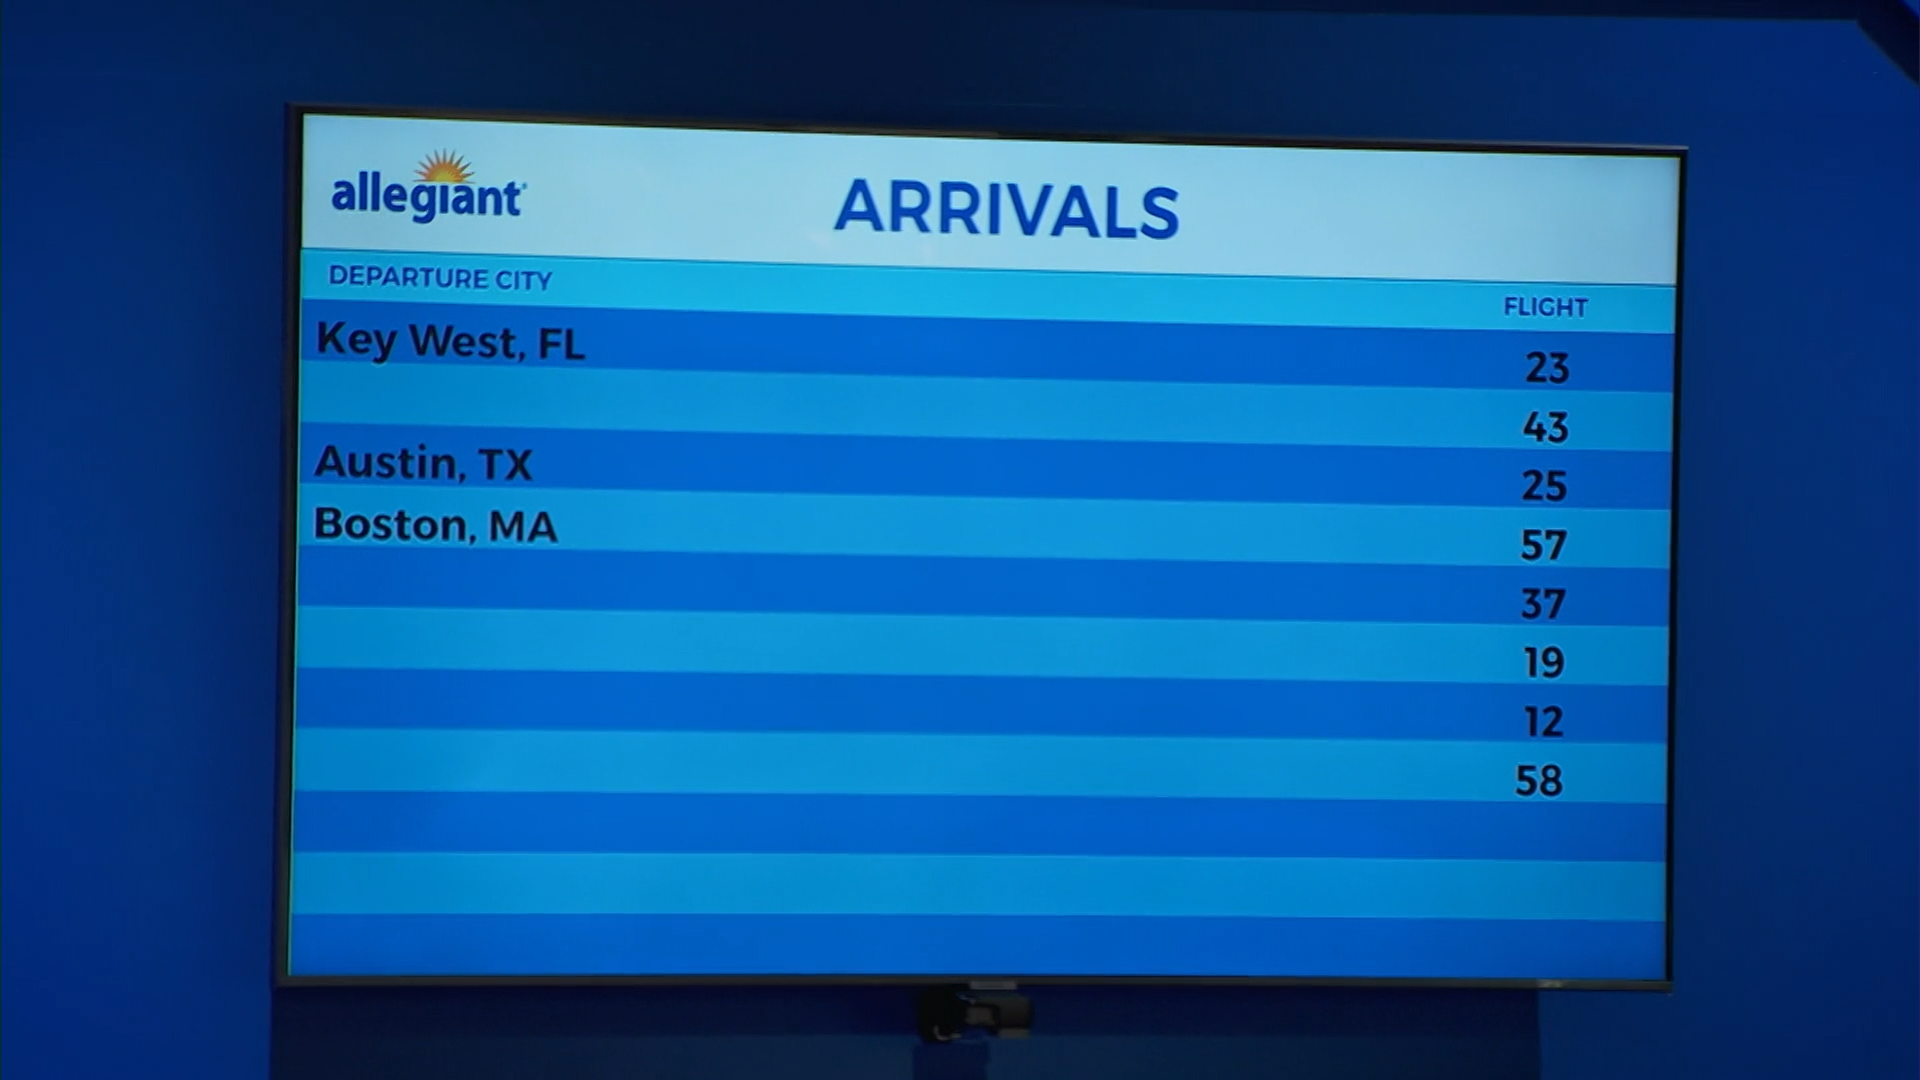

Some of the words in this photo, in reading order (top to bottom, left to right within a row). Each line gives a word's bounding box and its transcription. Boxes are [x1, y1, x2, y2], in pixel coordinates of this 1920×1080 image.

[332, 171, 522, 224] allegiant
[834, 178, 1180, 240] ARRIVALS
[329, 265, 489, 290] DEPARTURE
[495, 270, 553, 291] CITY
[1504, 297, 1589, 318] FLIGHT
[317, 321, 398, 364] Key
[409, 323, 526, 362] West,
[540, 328, 586, 360] FL
[1526, 351, 1570, 384] 23
[1523, 411, 1569, 444] 43
[314, 443, 466, 484] Austin,
[478, 448, 533, 481] TX
[1522, 469, 1568, 502] 25
[315, 506, 477, 545] Boston,
[490, 510, 558, 543] MA
[1521, 529, 1568, 561] 57
[1521, 588, 1567, 620] 37
[1524, 645, 1565, 679] 19
[1524, 705, 1564, 738] 12
[1515, 764, 1563, 797] 58
